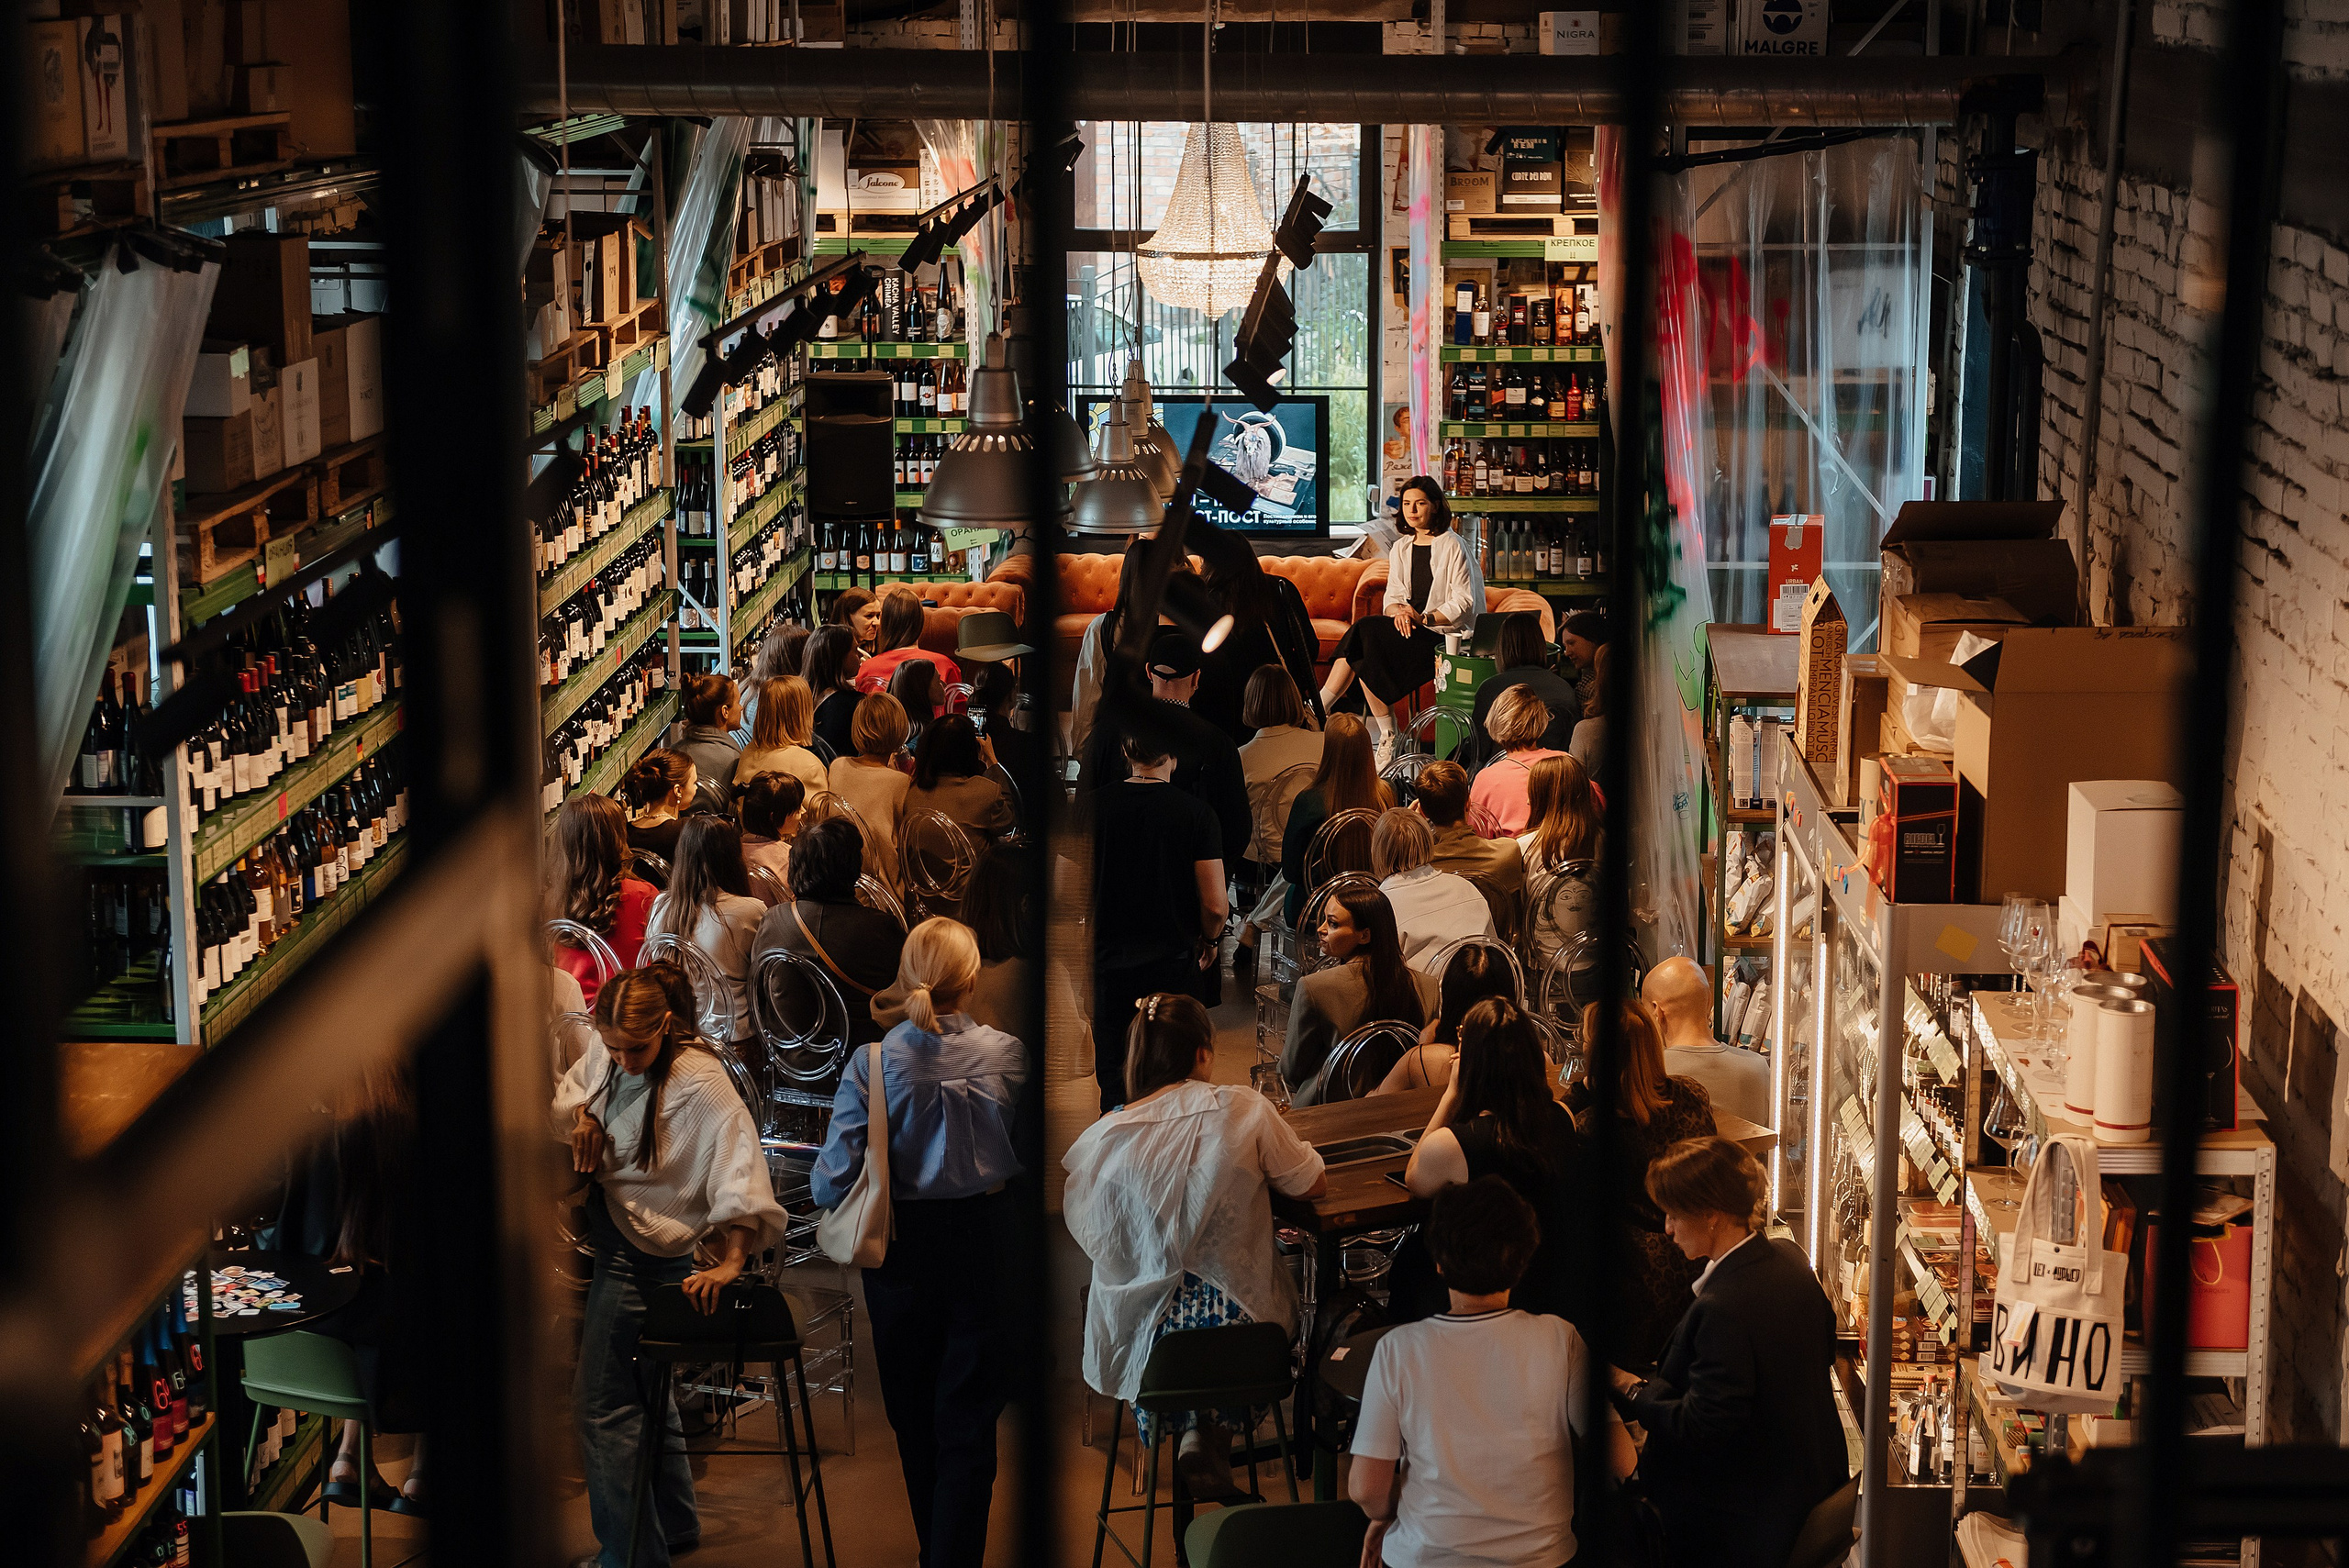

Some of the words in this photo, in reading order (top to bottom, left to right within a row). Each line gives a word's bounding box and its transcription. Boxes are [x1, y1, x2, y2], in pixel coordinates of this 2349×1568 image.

[1556, 30, 1595, 39] NIGRA
[1744, 39, 1819, 55] MALGRE
[865, 177, 899, 189] falcone
[1450, 176, 1489, 186] BROOM
[1551, 239, 1595, 247] КРЕПКОЕ
[884, 277, 892, 309] CRIMEA
[891, 277, 900, 304] KACHA
[891, 305, 900, 335] VALLEY
[1808, 660, 1819, 720] TEMPRANILLO
[1818, 660, 1832, 719] MENCIA
[1807, 721, 1816, 748] PINOT
[1993, 1303, 2111, 1391] ВИНО
